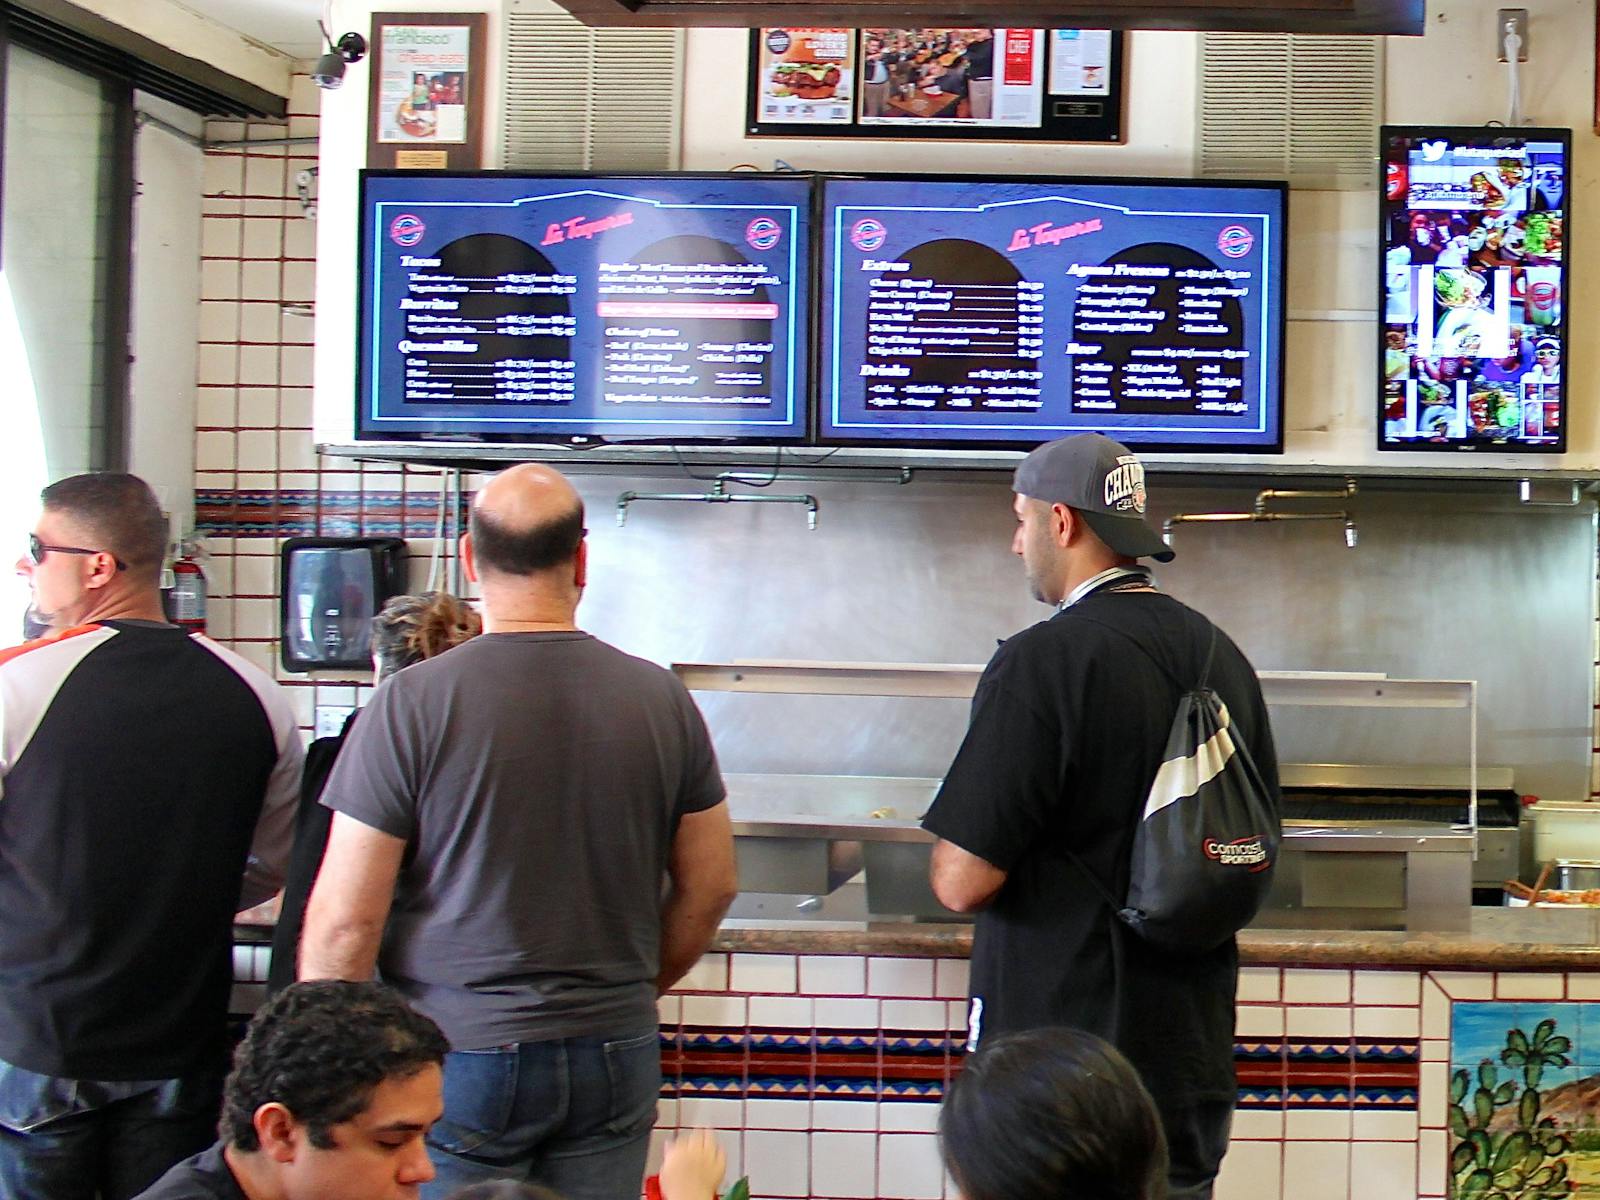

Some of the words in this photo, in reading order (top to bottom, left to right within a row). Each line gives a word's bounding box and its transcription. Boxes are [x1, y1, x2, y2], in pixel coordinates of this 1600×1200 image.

[861, 259, 911, 272] Extras
[1066, 343, 1102, 355] Beer
[859, 364, 911, 376] Drinks
